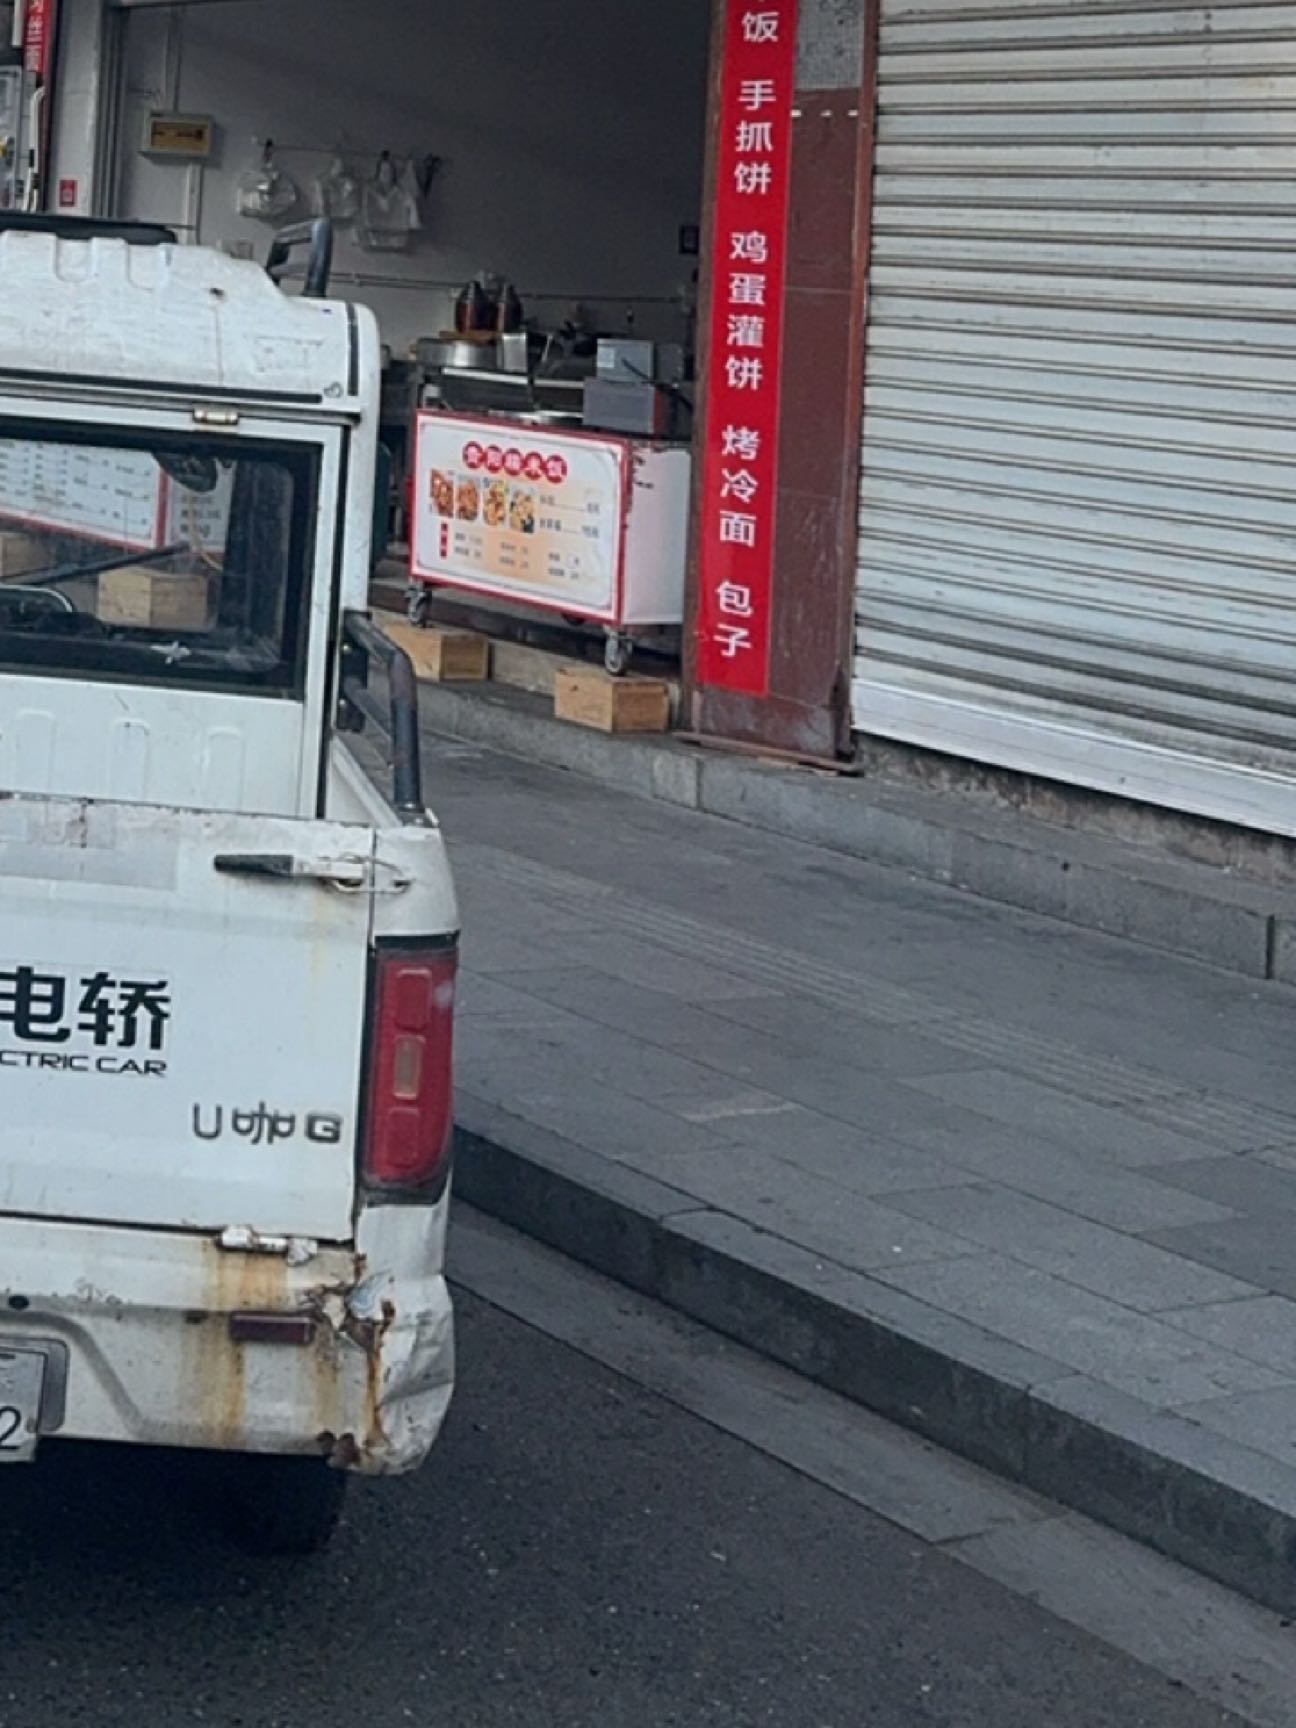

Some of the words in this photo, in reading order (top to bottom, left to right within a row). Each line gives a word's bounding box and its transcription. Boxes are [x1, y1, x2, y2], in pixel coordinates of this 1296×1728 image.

[734, 79, 776, 195] 手抓饼
[725, 231, 768, 391] 鸡蛋灌饼
[720, 425, 762, 547] 烤冷面
[713, 580, 755, 657] 包子
[95, 1057, 167, 1078] CAR
